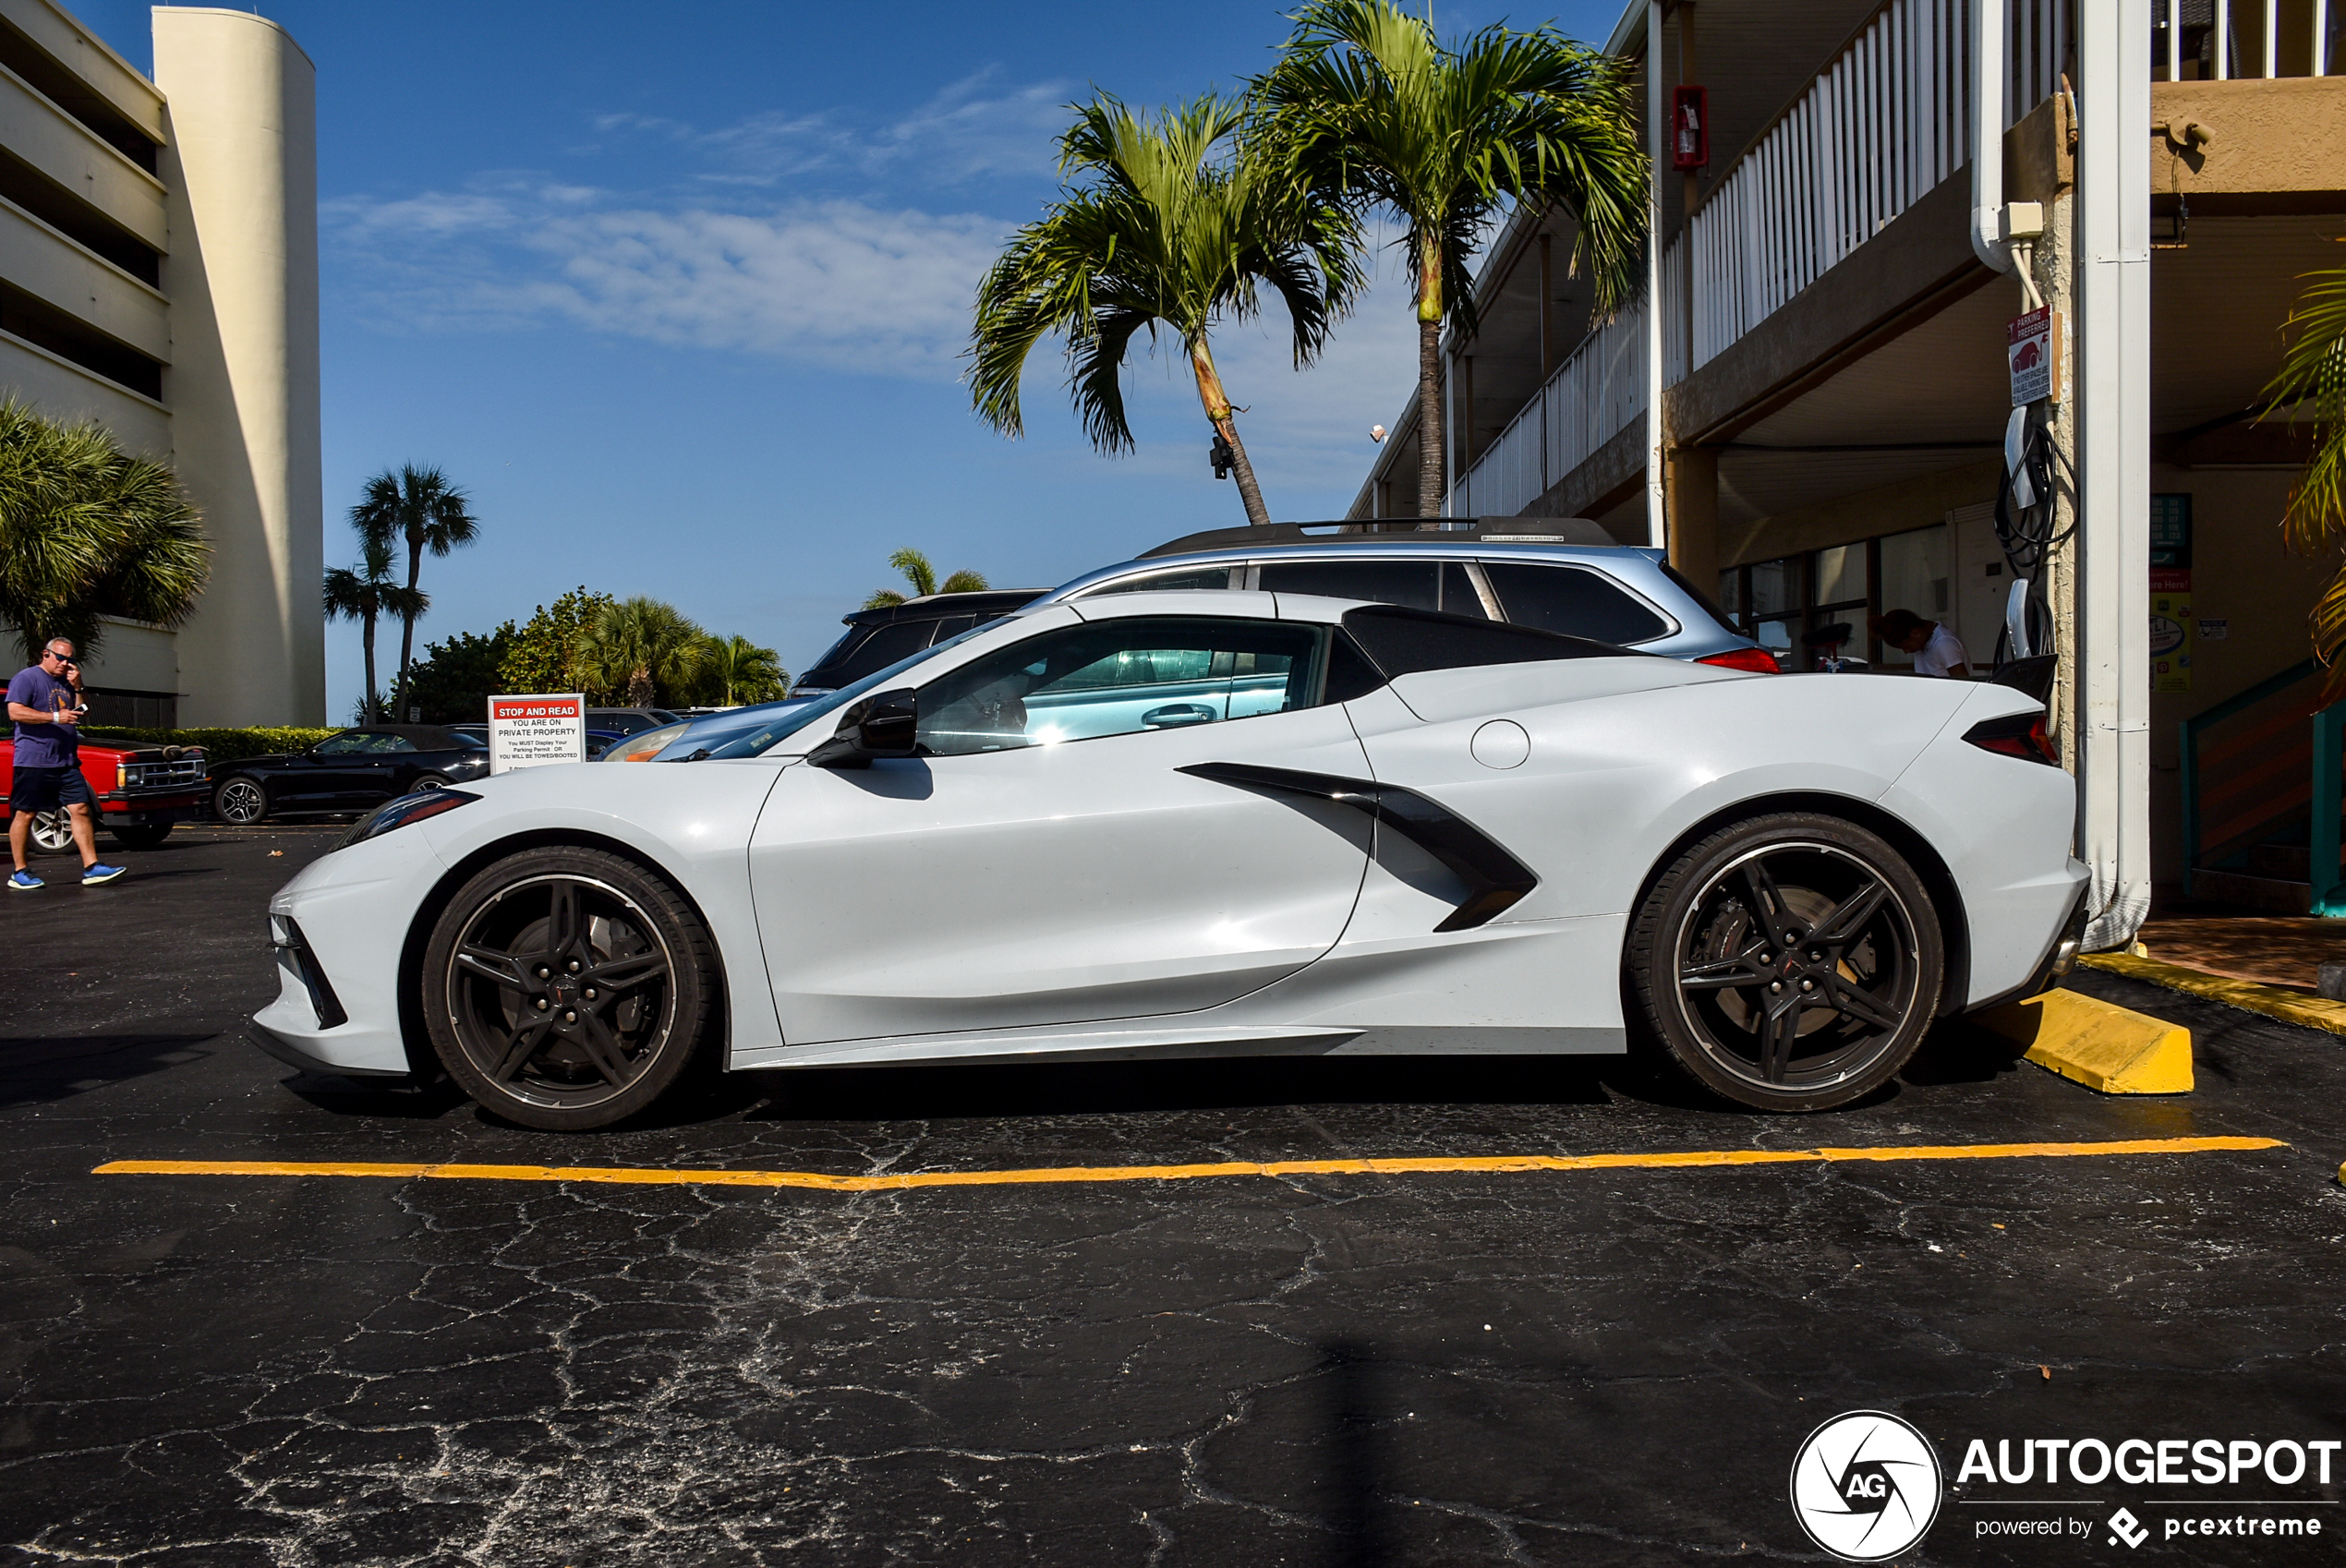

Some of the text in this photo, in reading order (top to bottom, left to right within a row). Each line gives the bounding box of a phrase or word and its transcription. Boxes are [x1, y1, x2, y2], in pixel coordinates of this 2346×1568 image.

[2017, 311, 2041, 329] PARKING
[2017, 320, 2050, 340] PREFERRED
[2020, 372, 2030, 382] OTHER
[2029, 368, 2042, 380] SPACES
[2028, 377, 2041, 388] PARKING
[2041, 374, 2050, 385] OPEN
[2022, 387, 2038, 401] REGISTERED
[2164, 580, 2188, 589] Here!
[499, 706, 574, 718] STOP AND READ
[533, 728, 576, 736] PROPERTY
